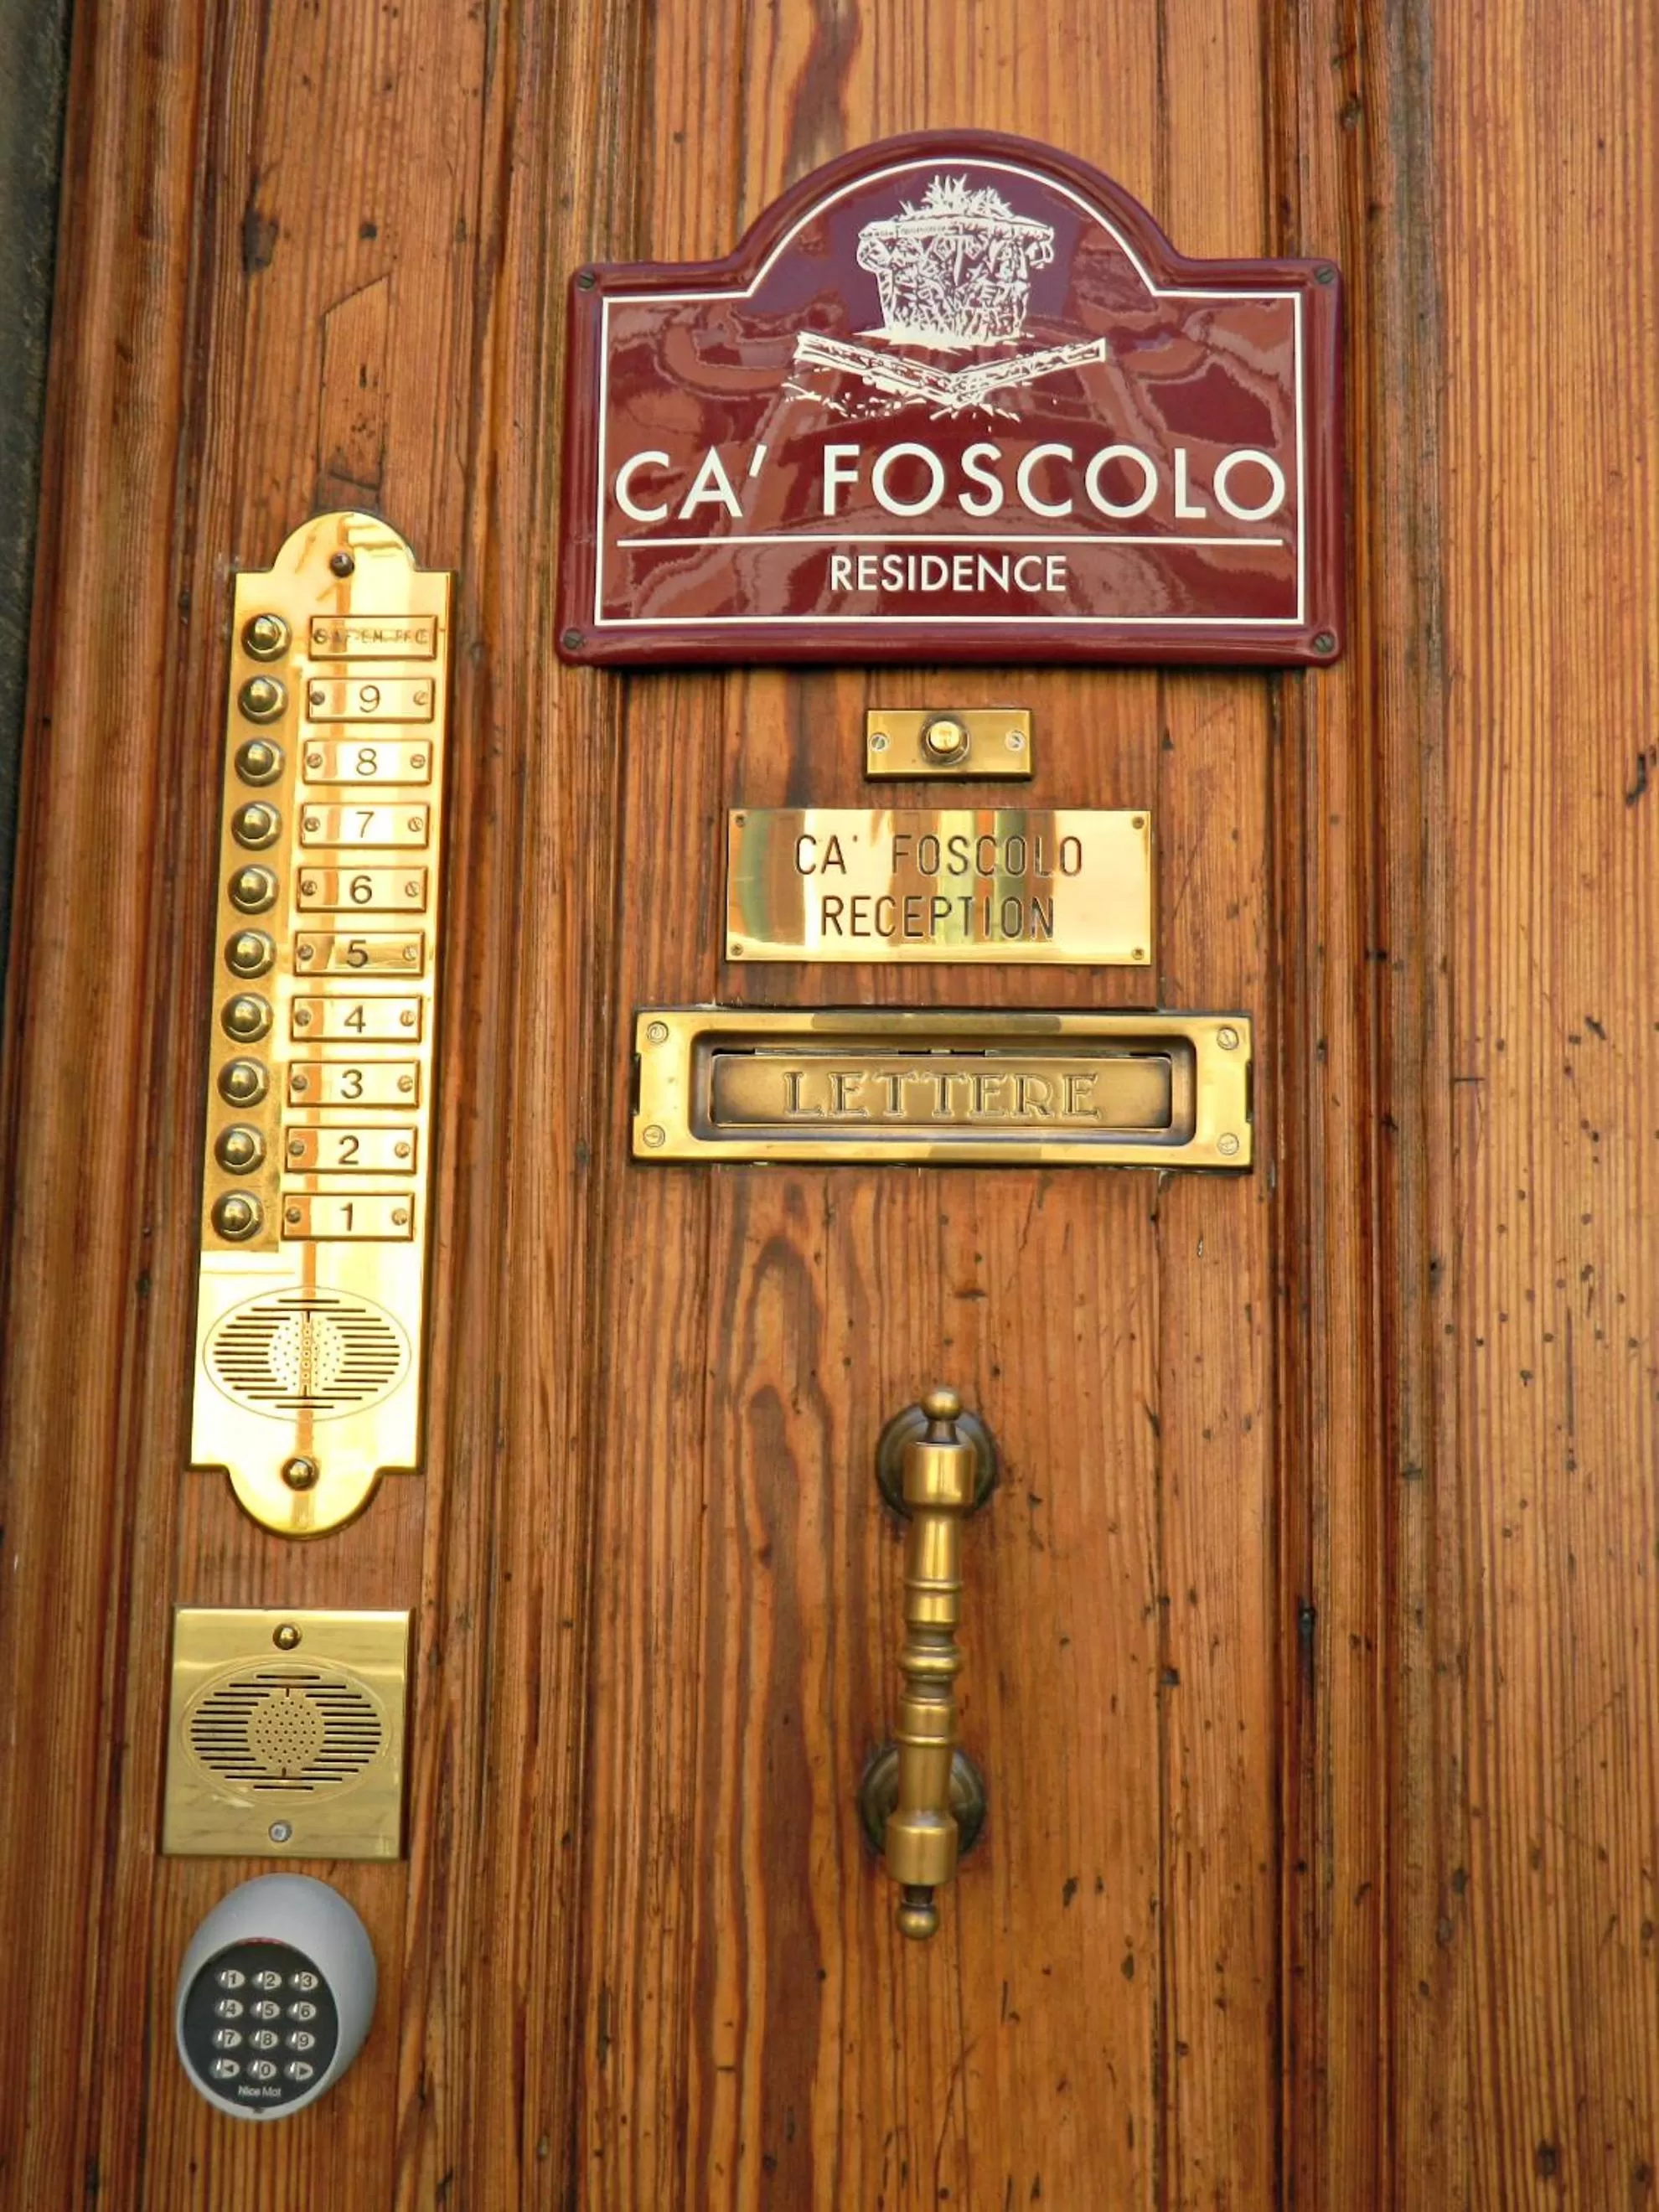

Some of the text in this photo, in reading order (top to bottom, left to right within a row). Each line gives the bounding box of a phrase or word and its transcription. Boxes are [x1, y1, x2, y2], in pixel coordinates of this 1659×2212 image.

[616, 443, 1286, 521] CA' FOSCOLO
[830, 555, 1067, 593] RESIDENCE
[359, 685, 380, 712] 9
[356, 748, 377, 775] 8
[356, 812, 375, 838] 7
[794, 834, 1083, 877] CA' FOSCOLO
[349, 876, 373, 904] 6
[821, 894, 1055, 938] RECEPTION
[346, 939, 370, 969] 5
[344, 1005, 366, 1034] 4
[341, 1069, 364, 1098] 3
[784, 1072, 1099, 1119] LETTERE
[338, 1135, 360, 1165] 2
[341, 1203, 354, 1231] 1
[266, 1974, 276, 1987] 2
[302, 1975, 313, 1987] 3
[264, 2004, 273, 2016] 5
[301, 2006, 310, 2018] 6
[225, 2033, 308, 2048] 7 8 9
